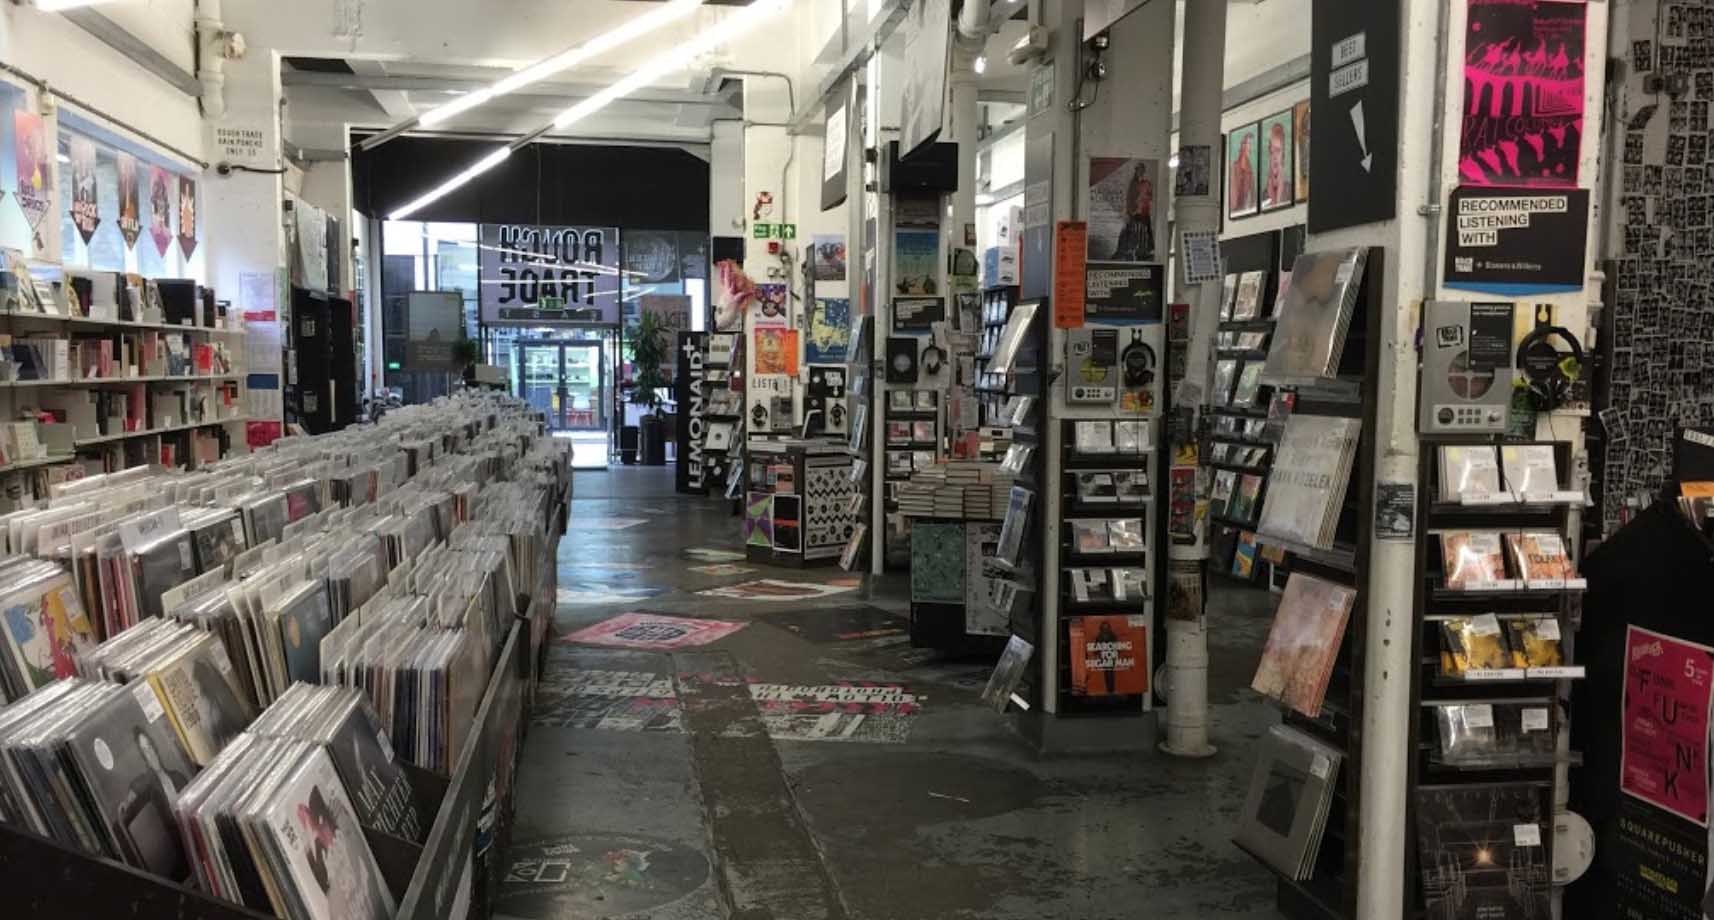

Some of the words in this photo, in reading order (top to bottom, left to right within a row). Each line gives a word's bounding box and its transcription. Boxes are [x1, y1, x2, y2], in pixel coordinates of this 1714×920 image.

[1461, 198, 1566, 212] RECOMMENDED
[1459, 213, 1528, 229] LISTENING
[1461, 231, 1496, 244] WITH
[1619, 816, 1705, 865] SQUAREPUSHER
